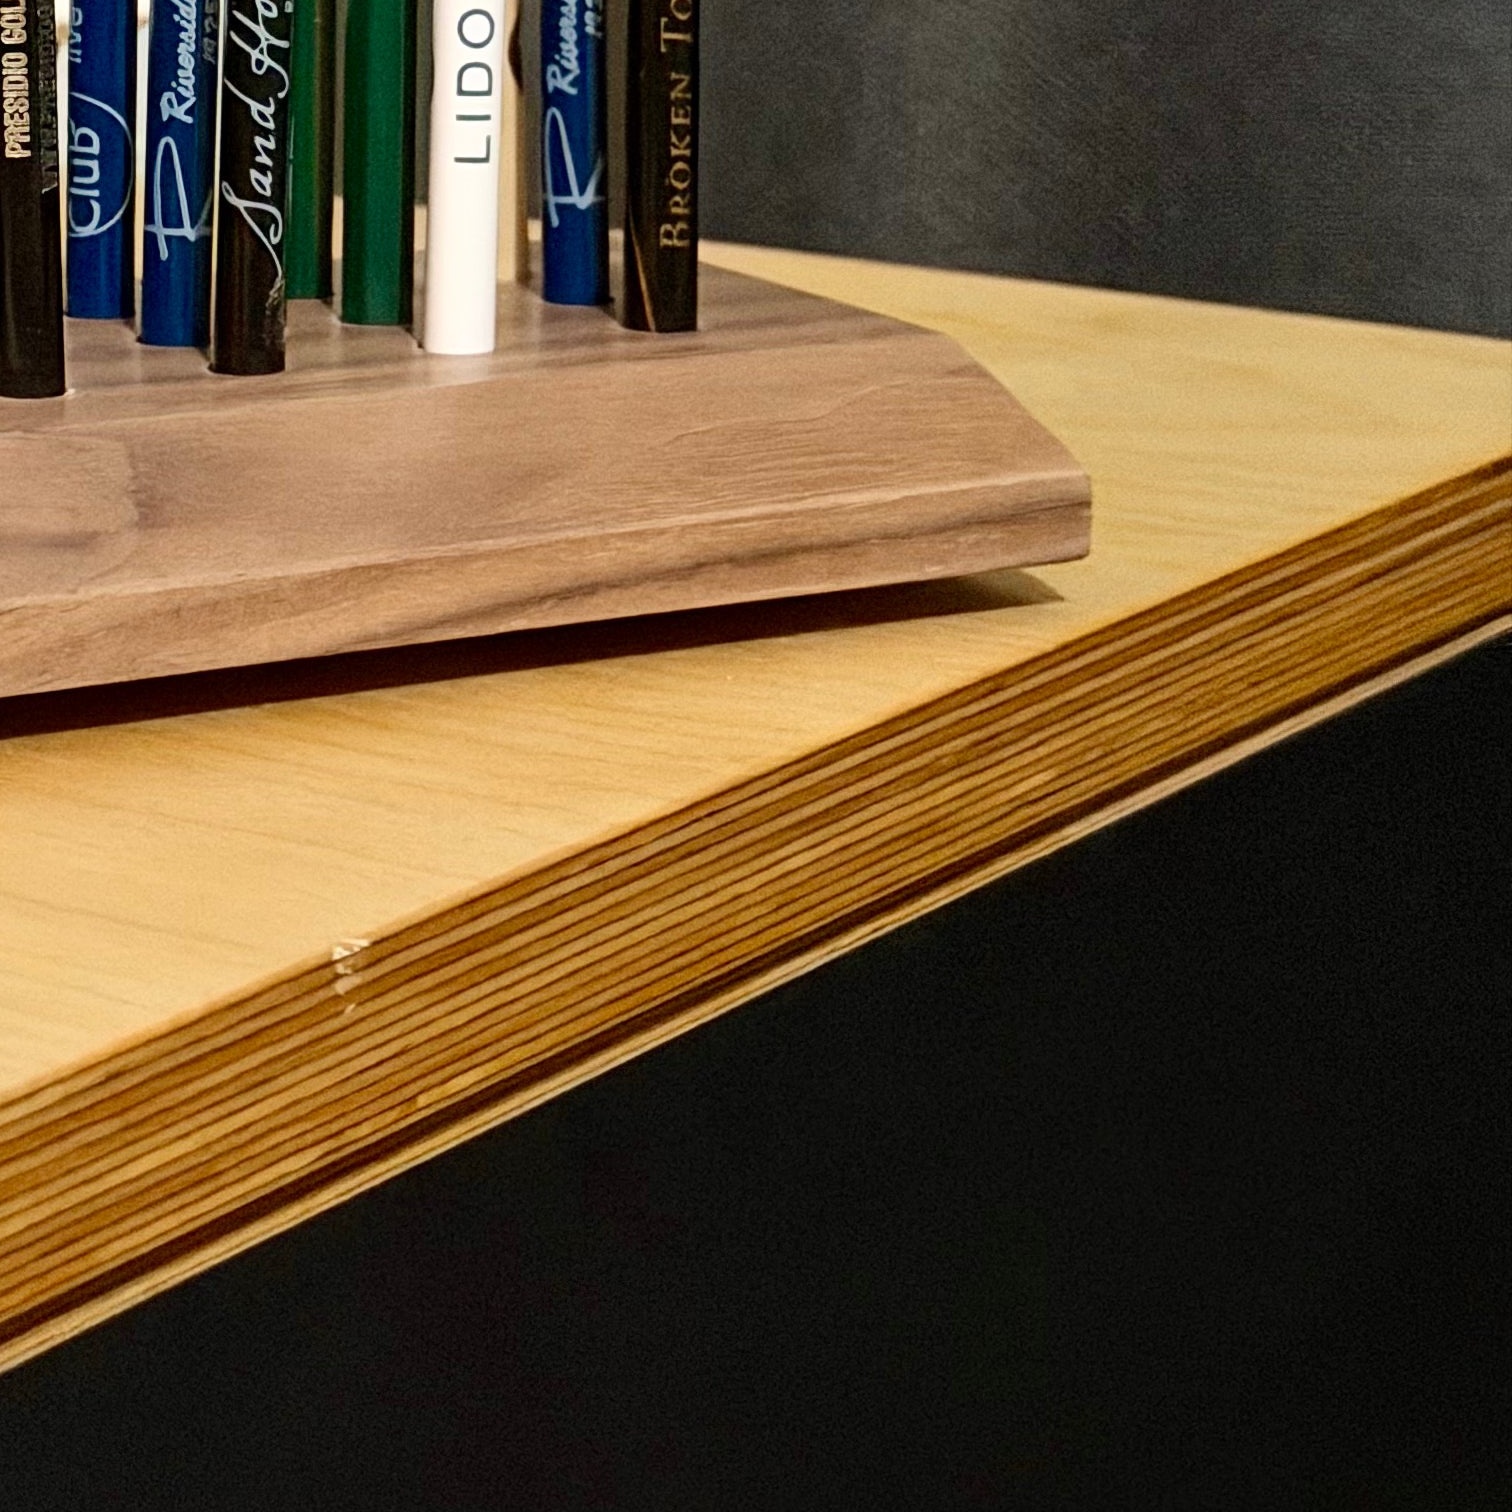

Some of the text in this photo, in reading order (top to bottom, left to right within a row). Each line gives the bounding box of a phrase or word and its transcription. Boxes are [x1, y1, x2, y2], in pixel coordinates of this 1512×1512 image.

[2, 52, 32, 159] PRESIDIO
[453, 8, 495, 164] LIDO
[659, 70, 693, 249] BROKEN
[221, 76, 285, 282] Sand
